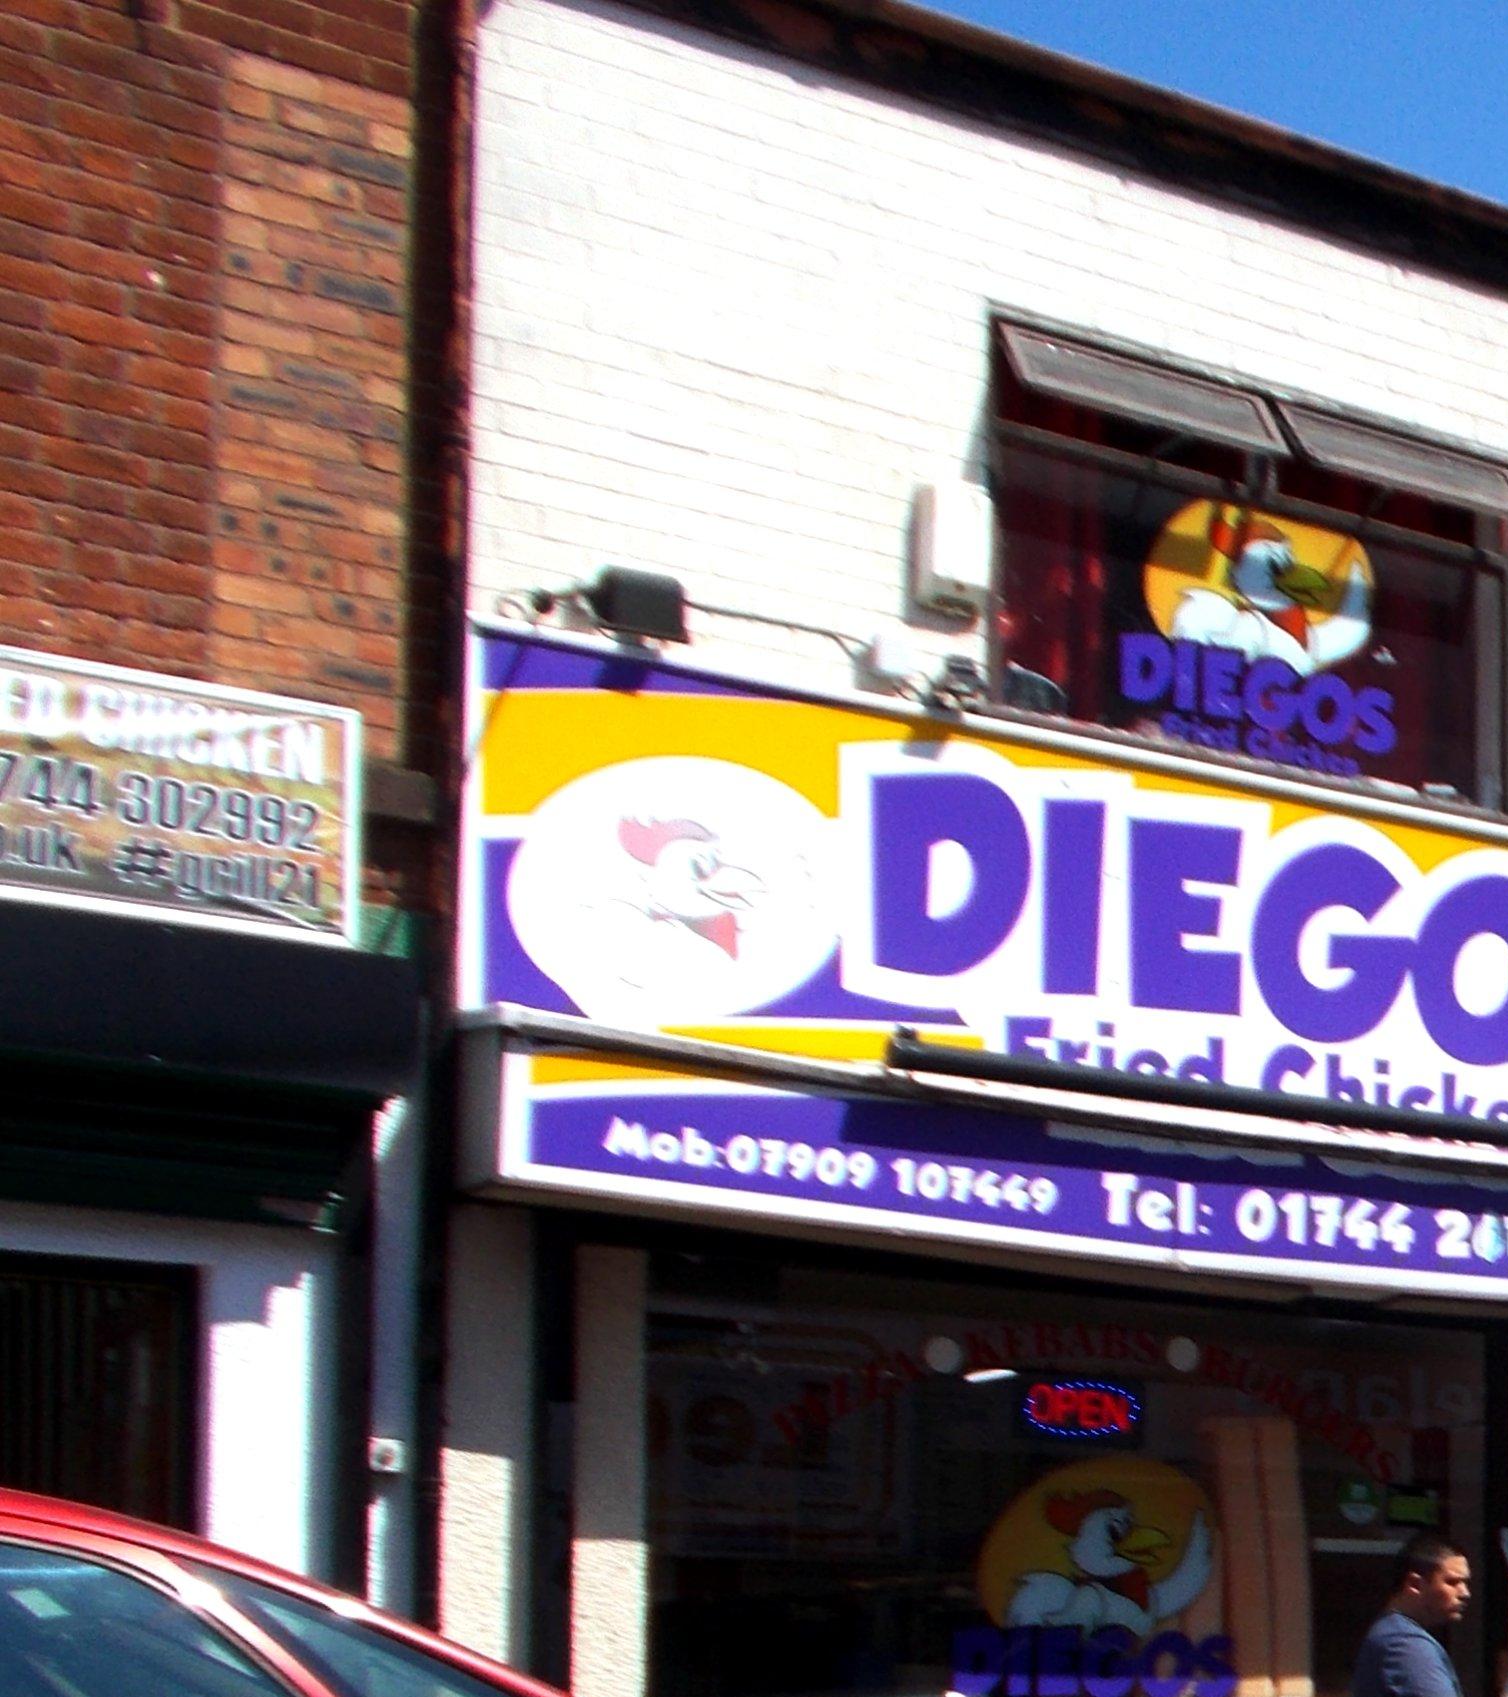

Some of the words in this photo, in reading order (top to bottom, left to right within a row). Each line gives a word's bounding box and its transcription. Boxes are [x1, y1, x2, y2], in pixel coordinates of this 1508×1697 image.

[83, 683, 324, 786] CHICKEN
[1118, 632, 1397, 755] DIEGOS
[117, 770, 322, 853] 302992
[113, 836, 323, 909] #grill21
[1101, 1170, 1213, 1236] Tel:
[1234, 1188, 1416, 1254] 01744
[963, 1320, 1159, 1369] KEBABS
[1029, 1381, 1134, 1433] OPEN
